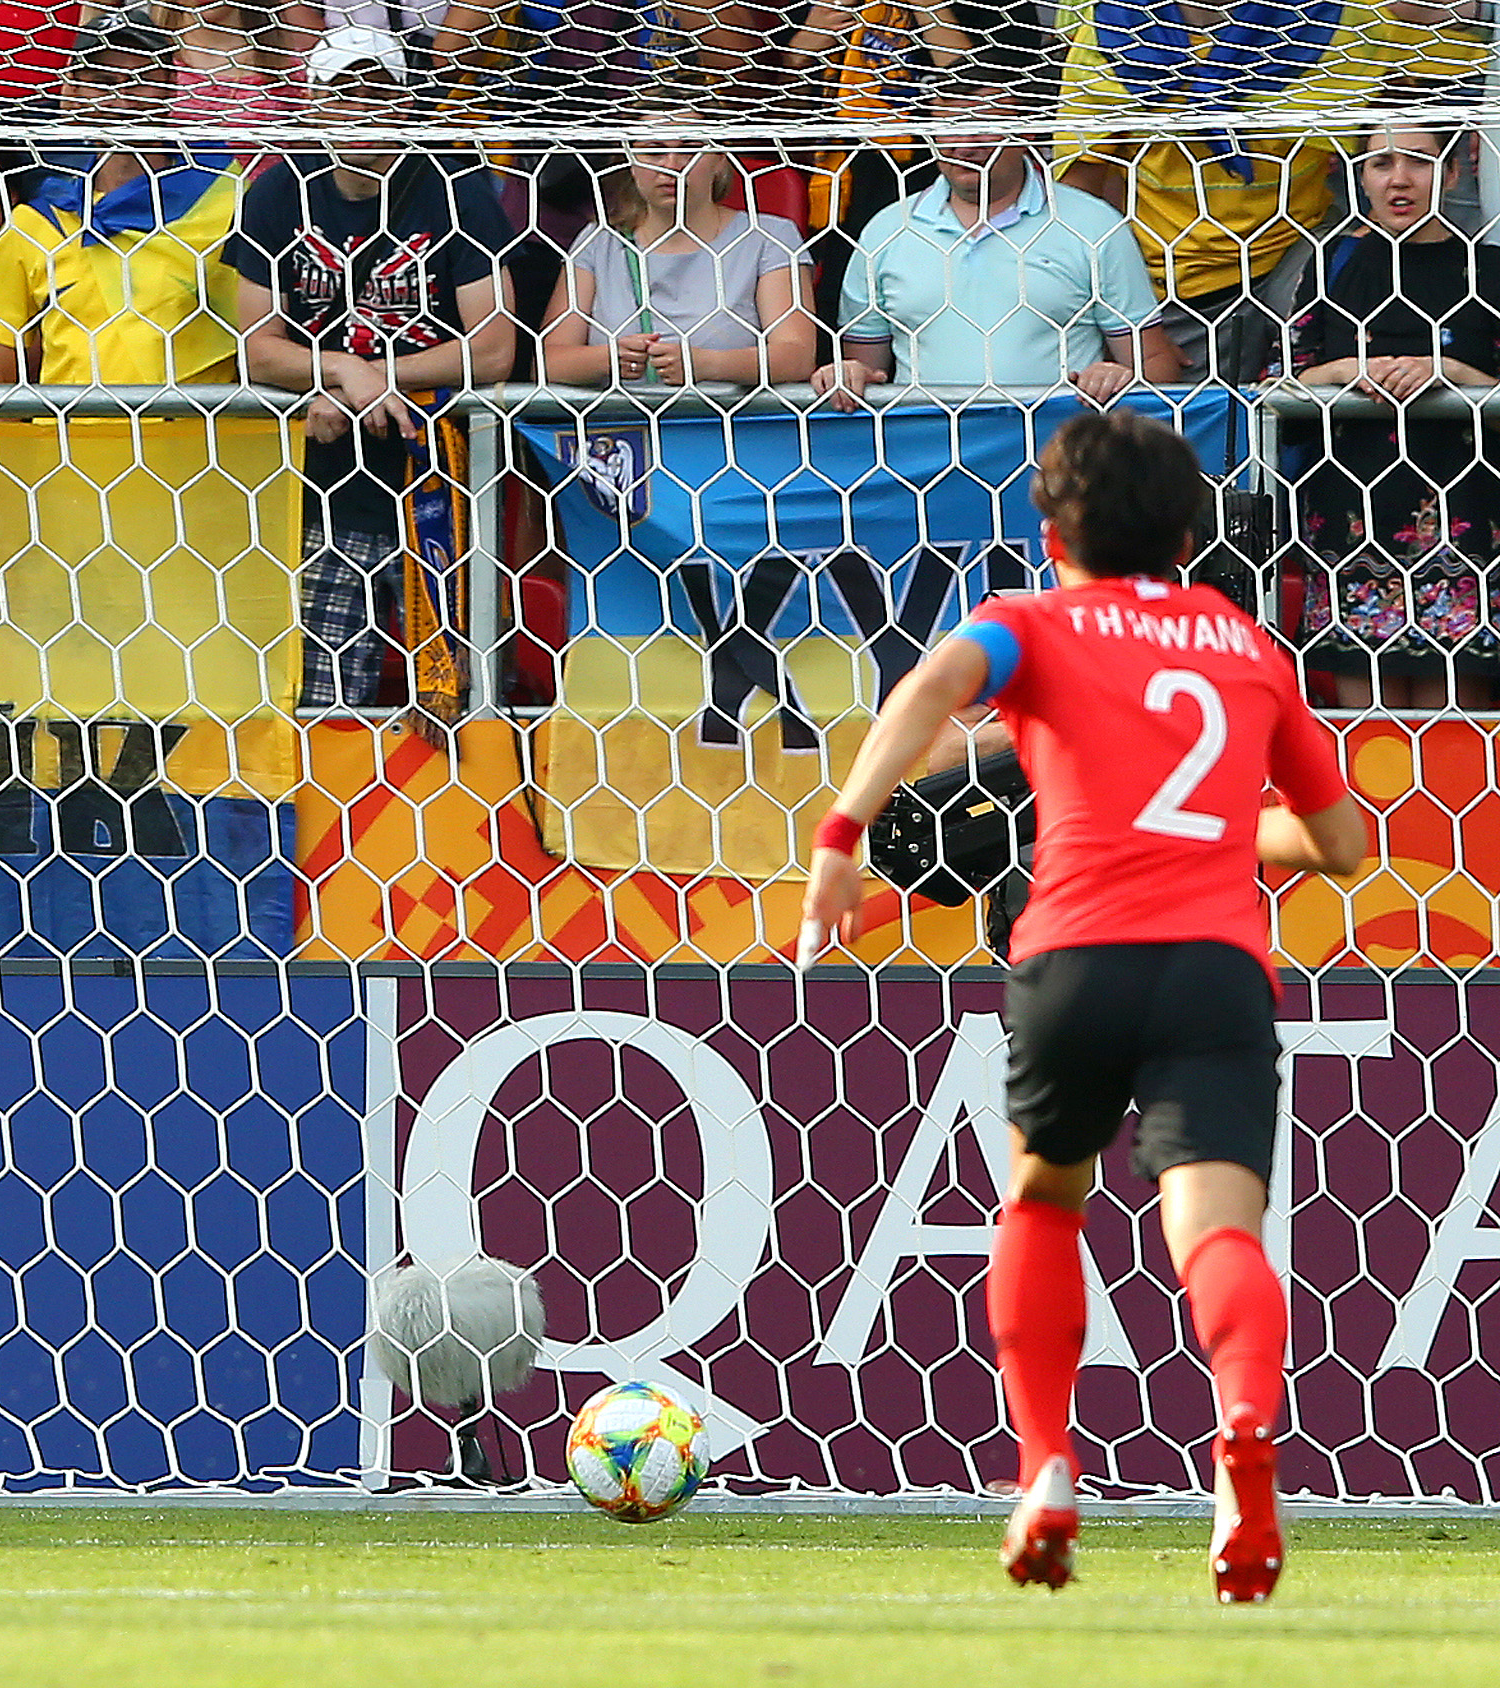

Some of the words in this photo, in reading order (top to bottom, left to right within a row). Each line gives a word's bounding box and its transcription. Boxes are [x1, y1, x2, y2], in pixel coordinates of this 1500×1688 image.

[1069, 605, 1086, 634] T
[1094, 603, 1125, 639] H
[1132, 667, 1229, 842] 2
